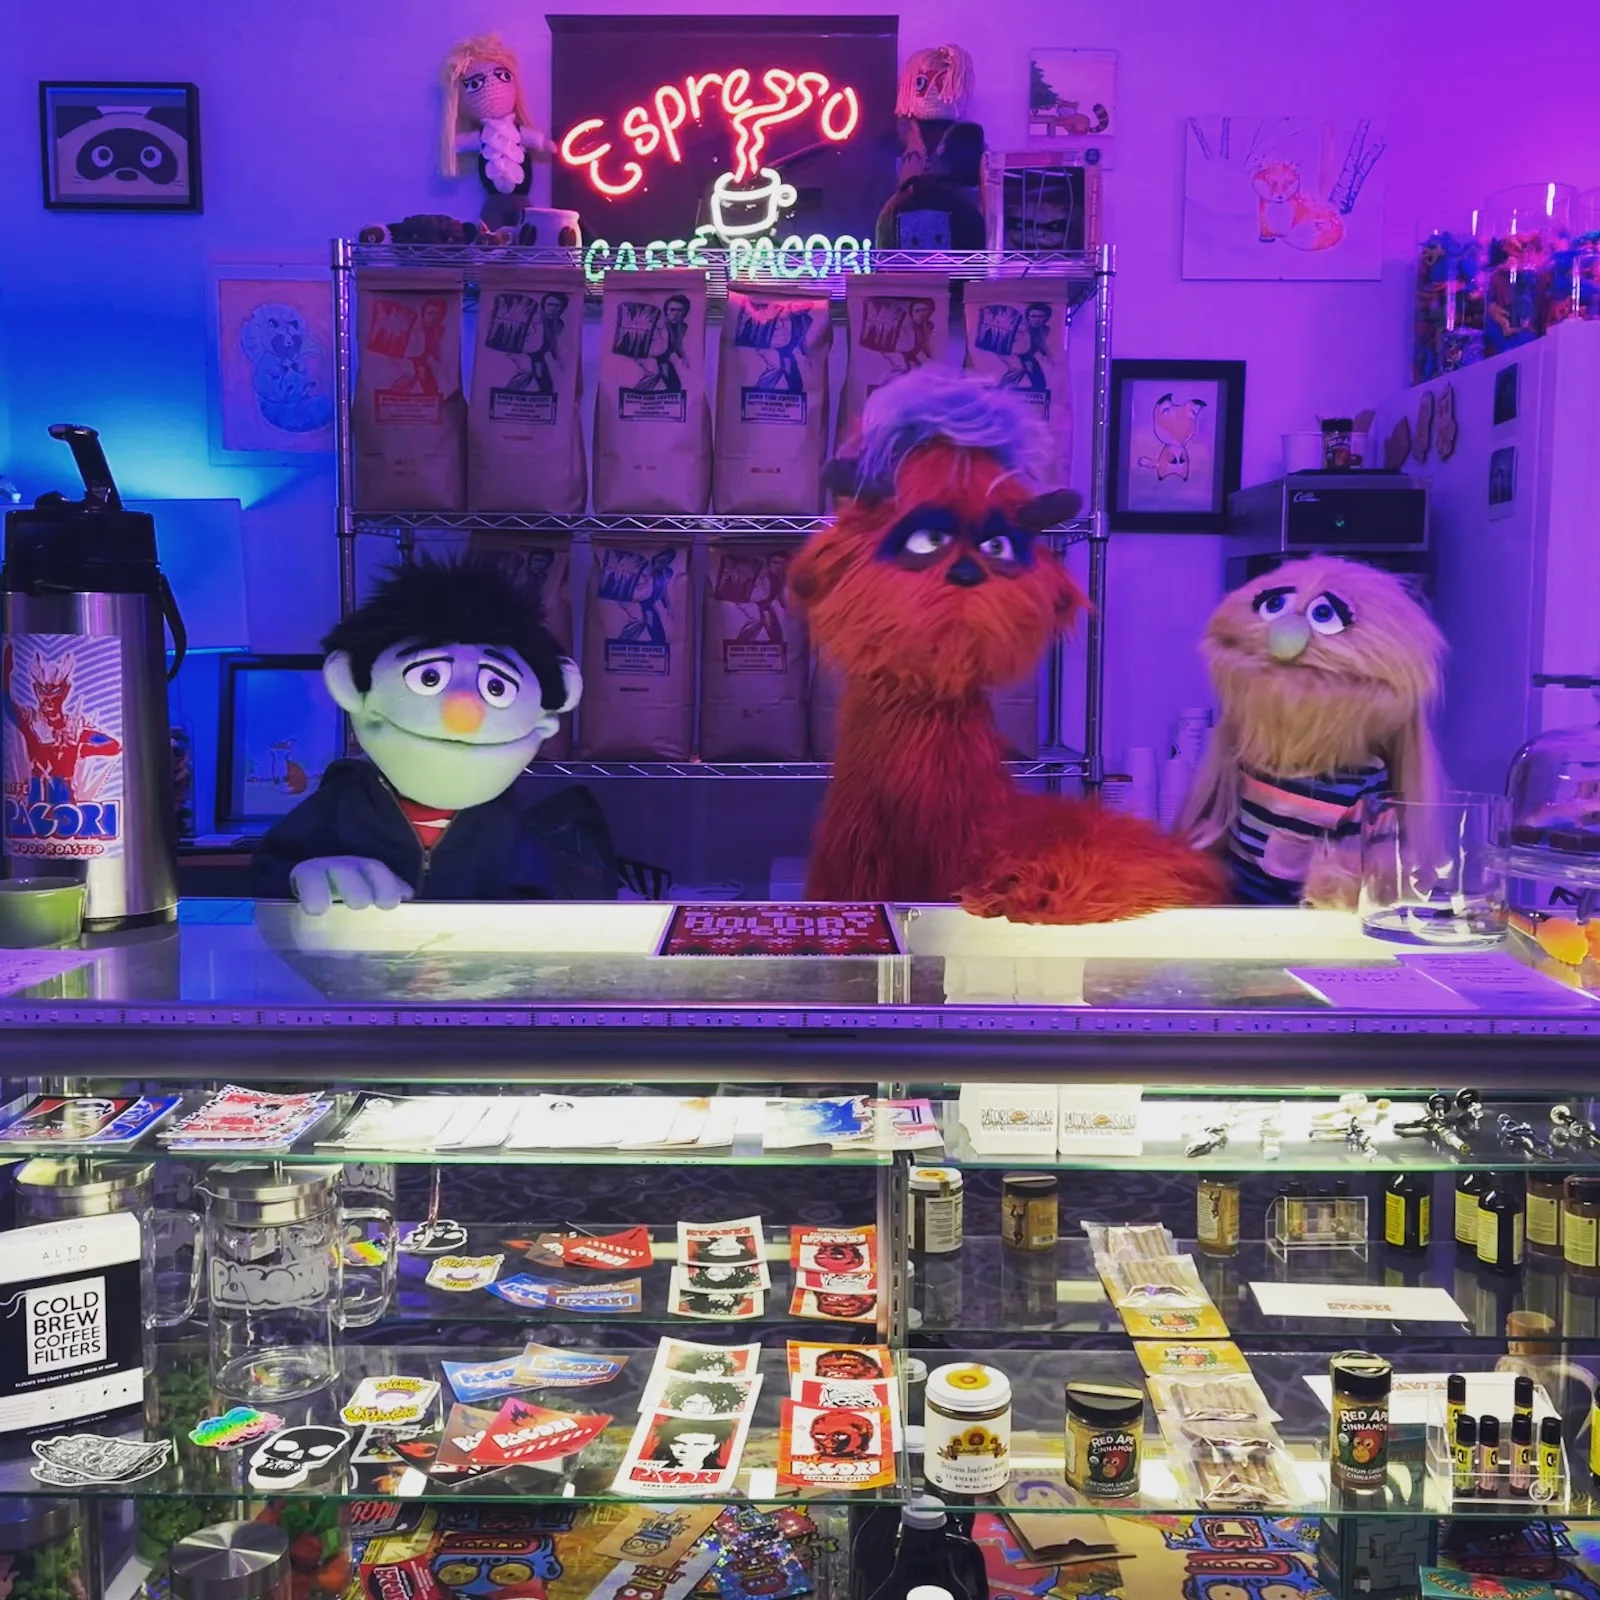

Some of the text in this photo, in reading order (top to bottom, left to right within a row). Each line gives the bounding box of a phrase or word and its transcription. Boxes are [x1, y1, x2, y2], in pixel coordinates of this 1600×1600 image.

[561, 67, 859, 196] Espresso
[729, 234, 872, 281] PACORI
[3, 799, 119, 839] PACORI
[684, 911, 877, 929] HOLIDAY
[42, 1244, 88, 1260] ALTO
[33, 1291, 99, 1317] COLD
[34, 1307, 99, 1336] BREW
[34, 1325, 101, 1350] COFFEE
[34, 1339, 101, 1365] FILTERS
[1341, 1409, 1367, 1423] RED
[1091, 1435, 1115, 1449] RED
[790, 1460, 882, 1476] PACORI
